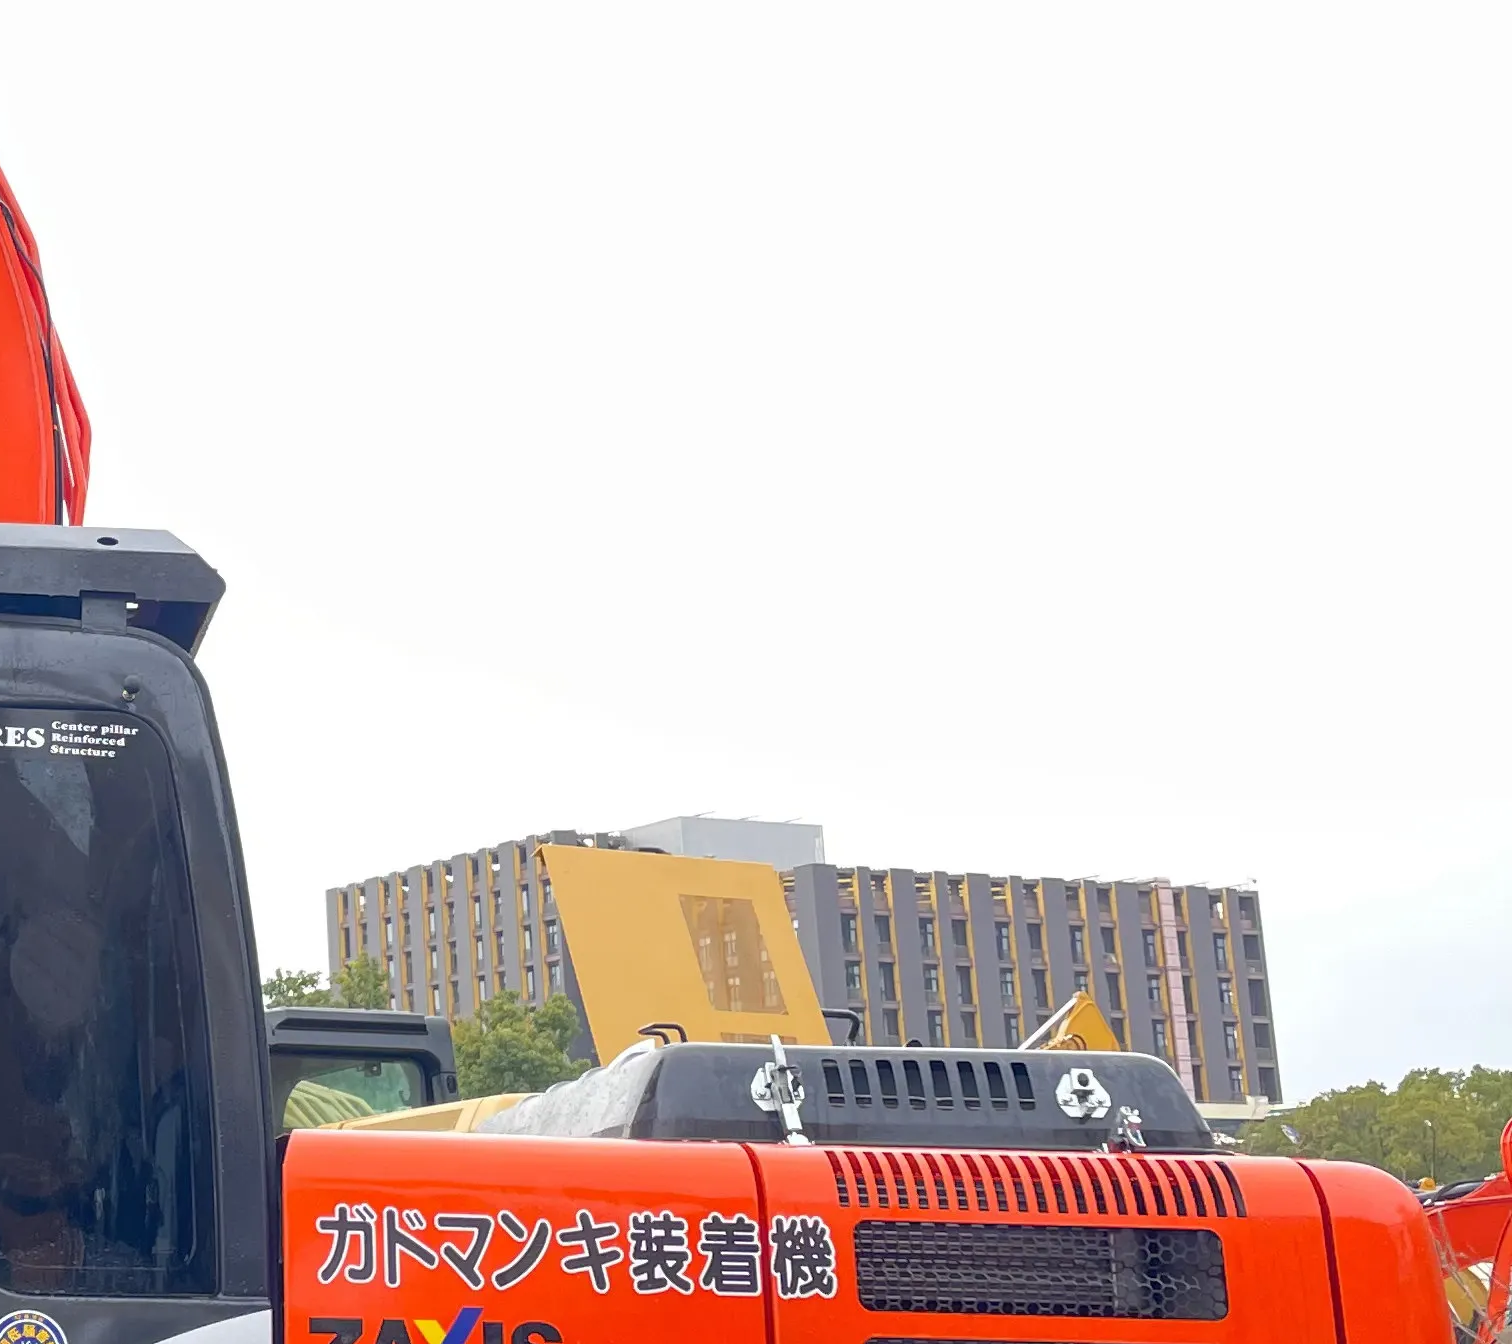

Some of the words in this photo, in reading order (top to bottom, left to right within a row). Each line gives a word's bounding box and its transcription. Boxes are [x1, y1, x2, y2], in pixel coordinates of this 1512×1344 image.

[51, 720, 97, 733] Center
[101, 724, 139, 736] pillar
[51, 732, 126, 747] Reinforced
[49, 744, 116, 758] Structure
[316, 1203, 839, 1300] ガドマンキ装着機
